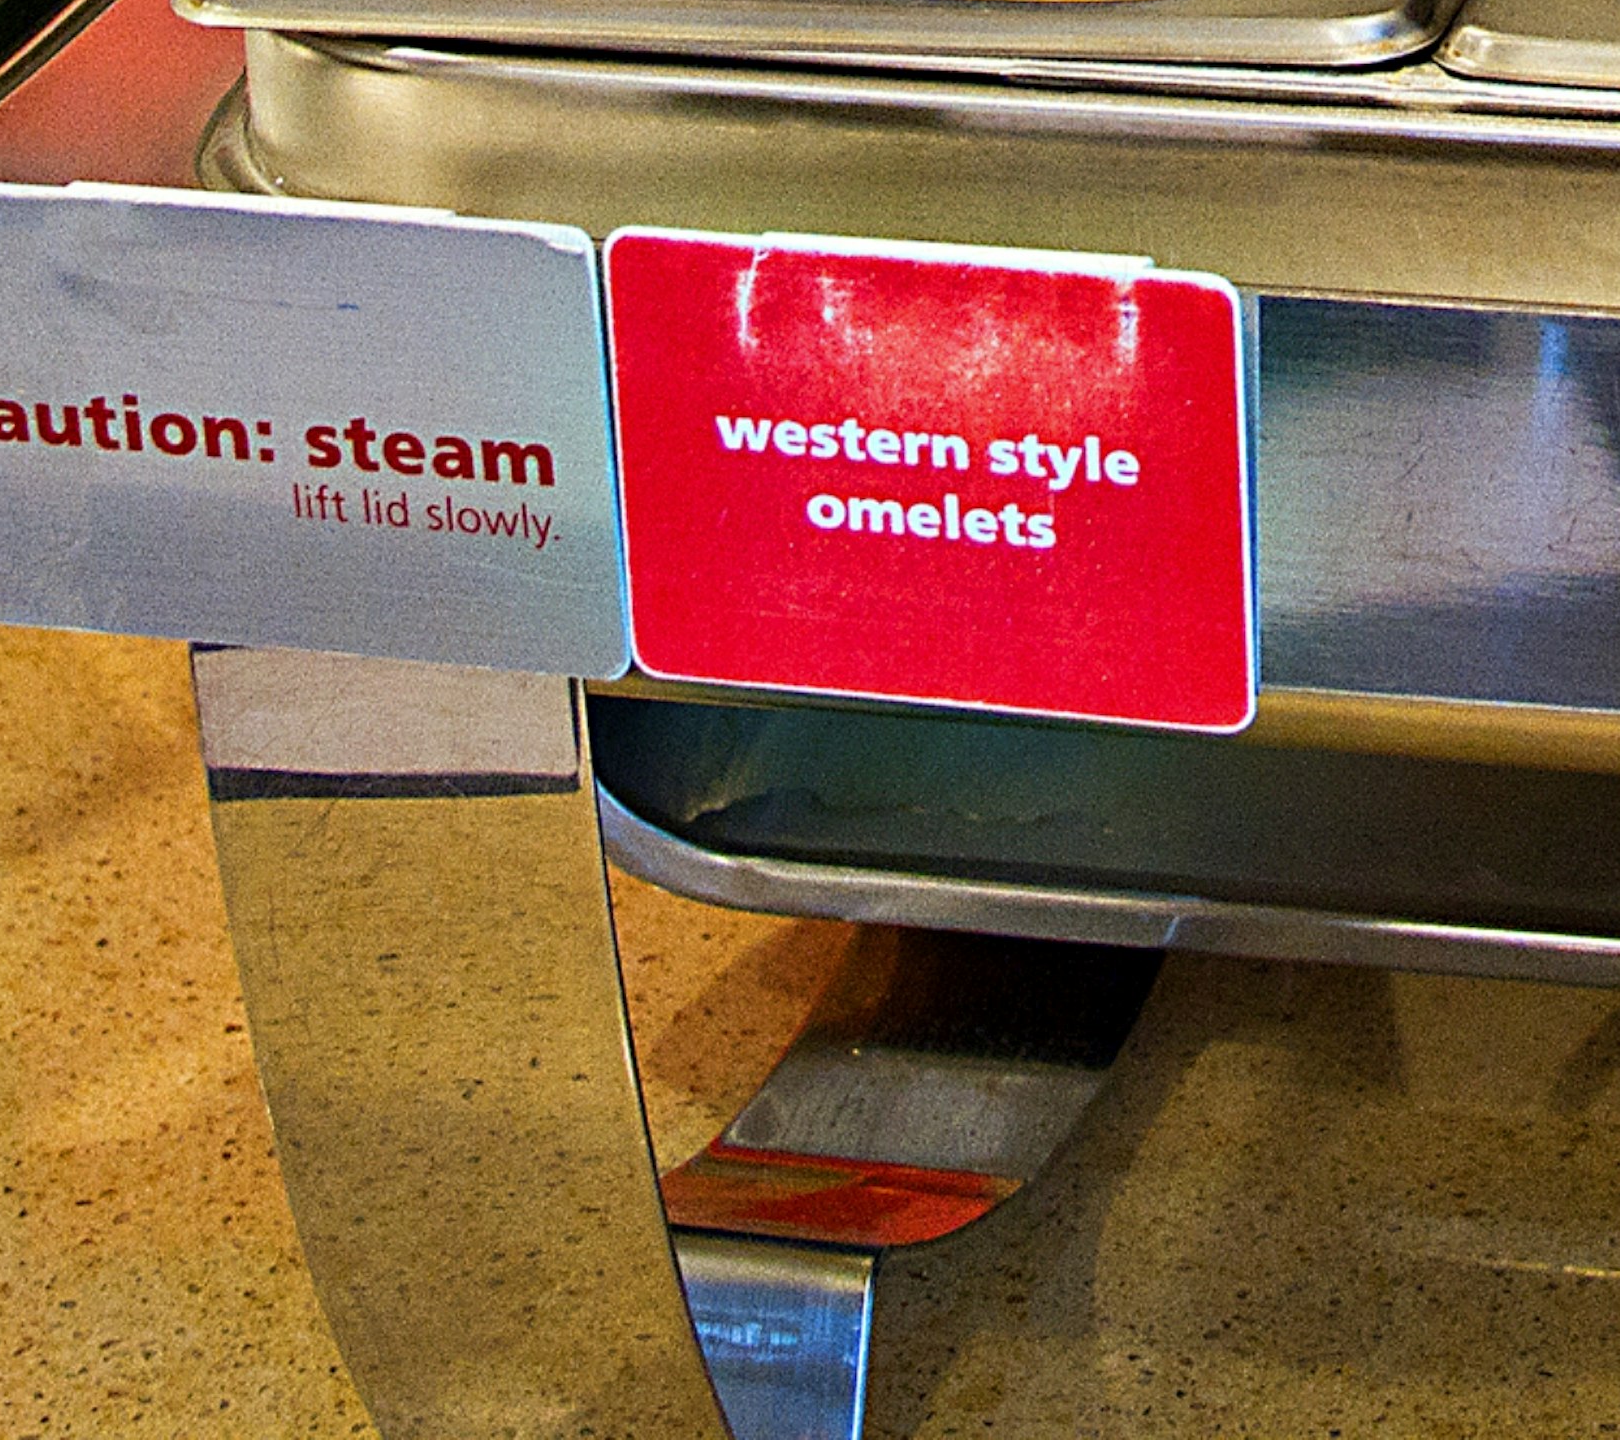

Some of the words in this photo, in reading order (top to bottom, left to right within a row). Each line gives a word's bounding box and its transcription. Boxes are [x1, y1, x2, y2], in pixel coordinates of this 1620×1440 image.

[305, 417, 555, 487] steam
[715, 415, 969, 470] western
[989, 433, 1141, 491] style
[292, 484, 346, 525] lift
[362, 487, 409, 528] lid
[426, 497, 561, 549] slowly.
[806, 492, 1057, 549] omelets
